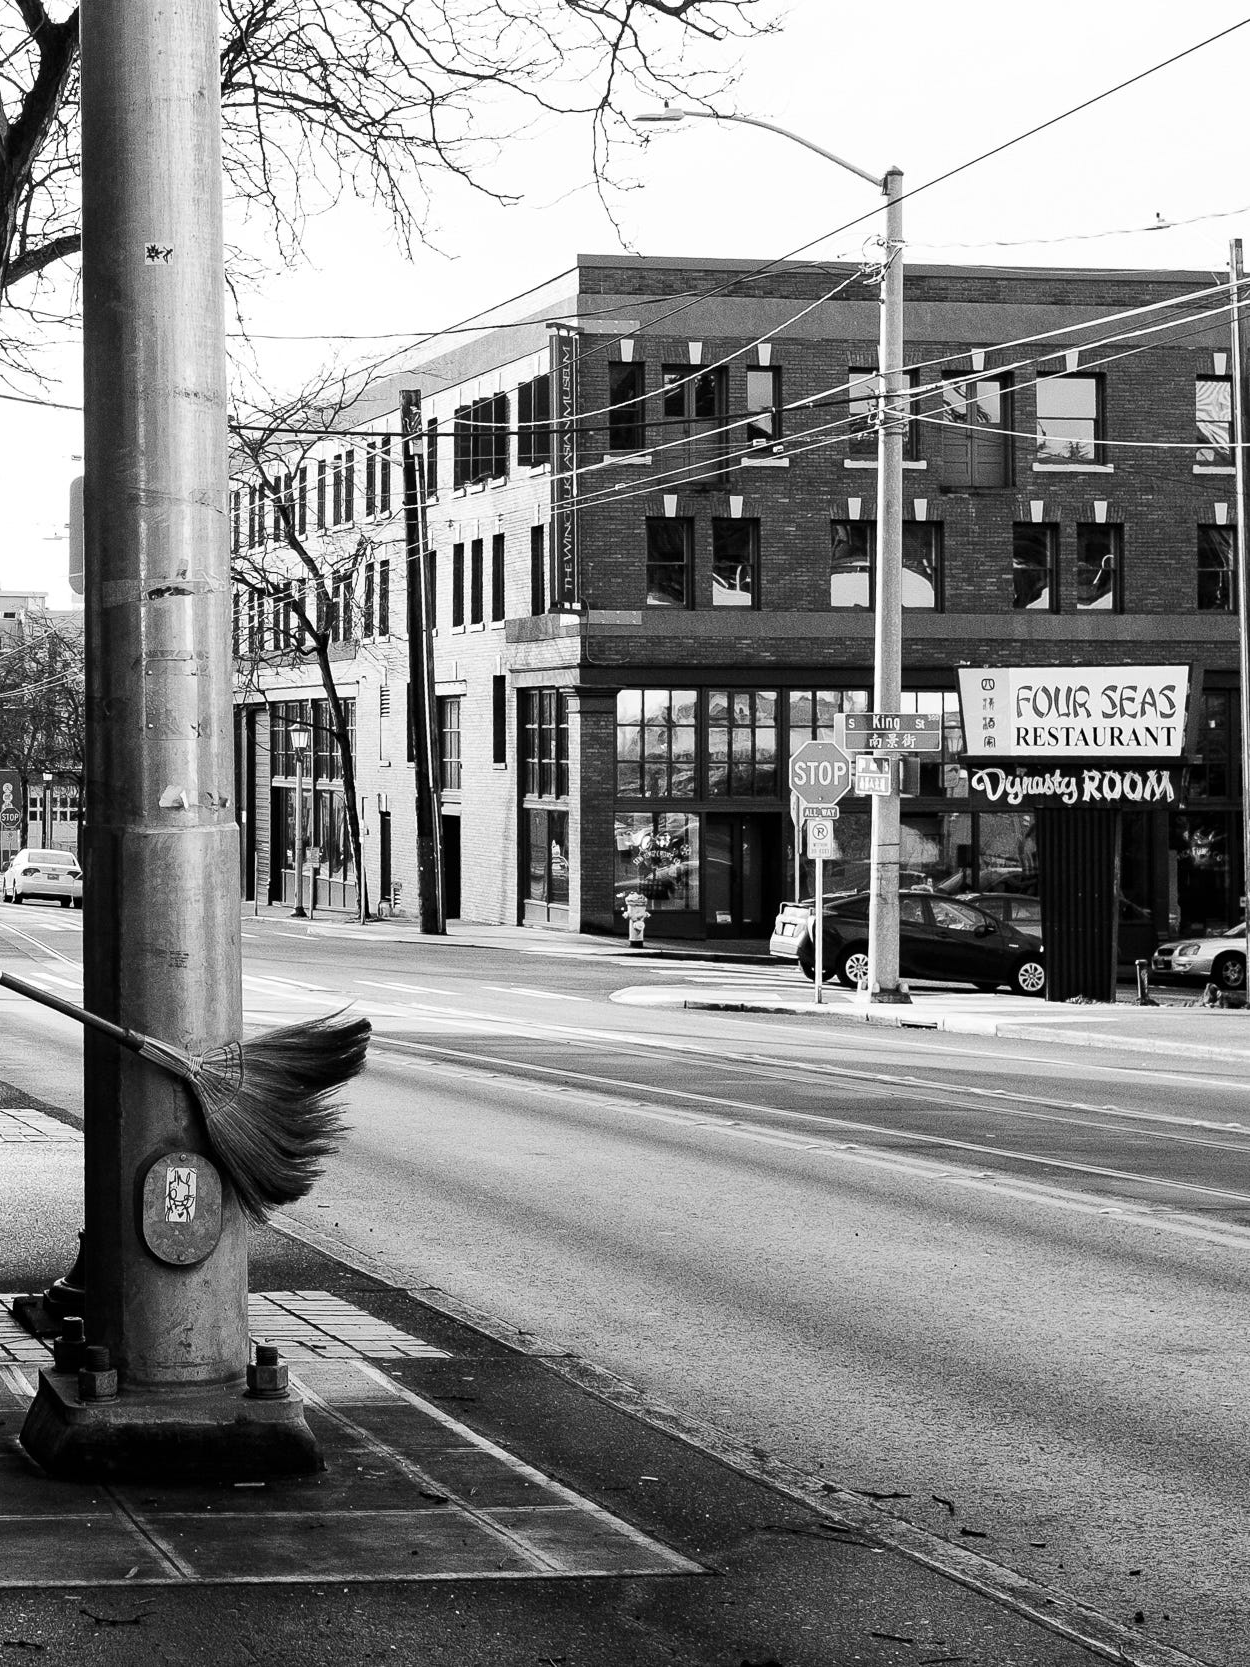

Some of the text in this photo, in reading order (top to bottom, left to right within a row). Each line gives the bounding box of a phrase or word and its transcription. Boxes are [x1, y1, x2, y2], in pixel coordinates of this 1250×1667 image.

[562, 345, 572, 418] MUSEUM
[563, 511, 572, 561] WING
[564, 562, 573, 592] THE
[1016, 684, 1177, 719] FOUR SEAS
[848, 718, 856, 729] S
[872, 714, 900, 731] King
[915, 718, 925, 729] St
[869, 733, 916, 749] 南景街
[1016, 726, 1177, 747] RESTAURANT
[794, 761, 847, 786] STOP
[971, 768, 1175, 805] Dynasty ROOM
[1, 813, 19, 822] STOP
[804, 808, 836, 817] ALL WAY
